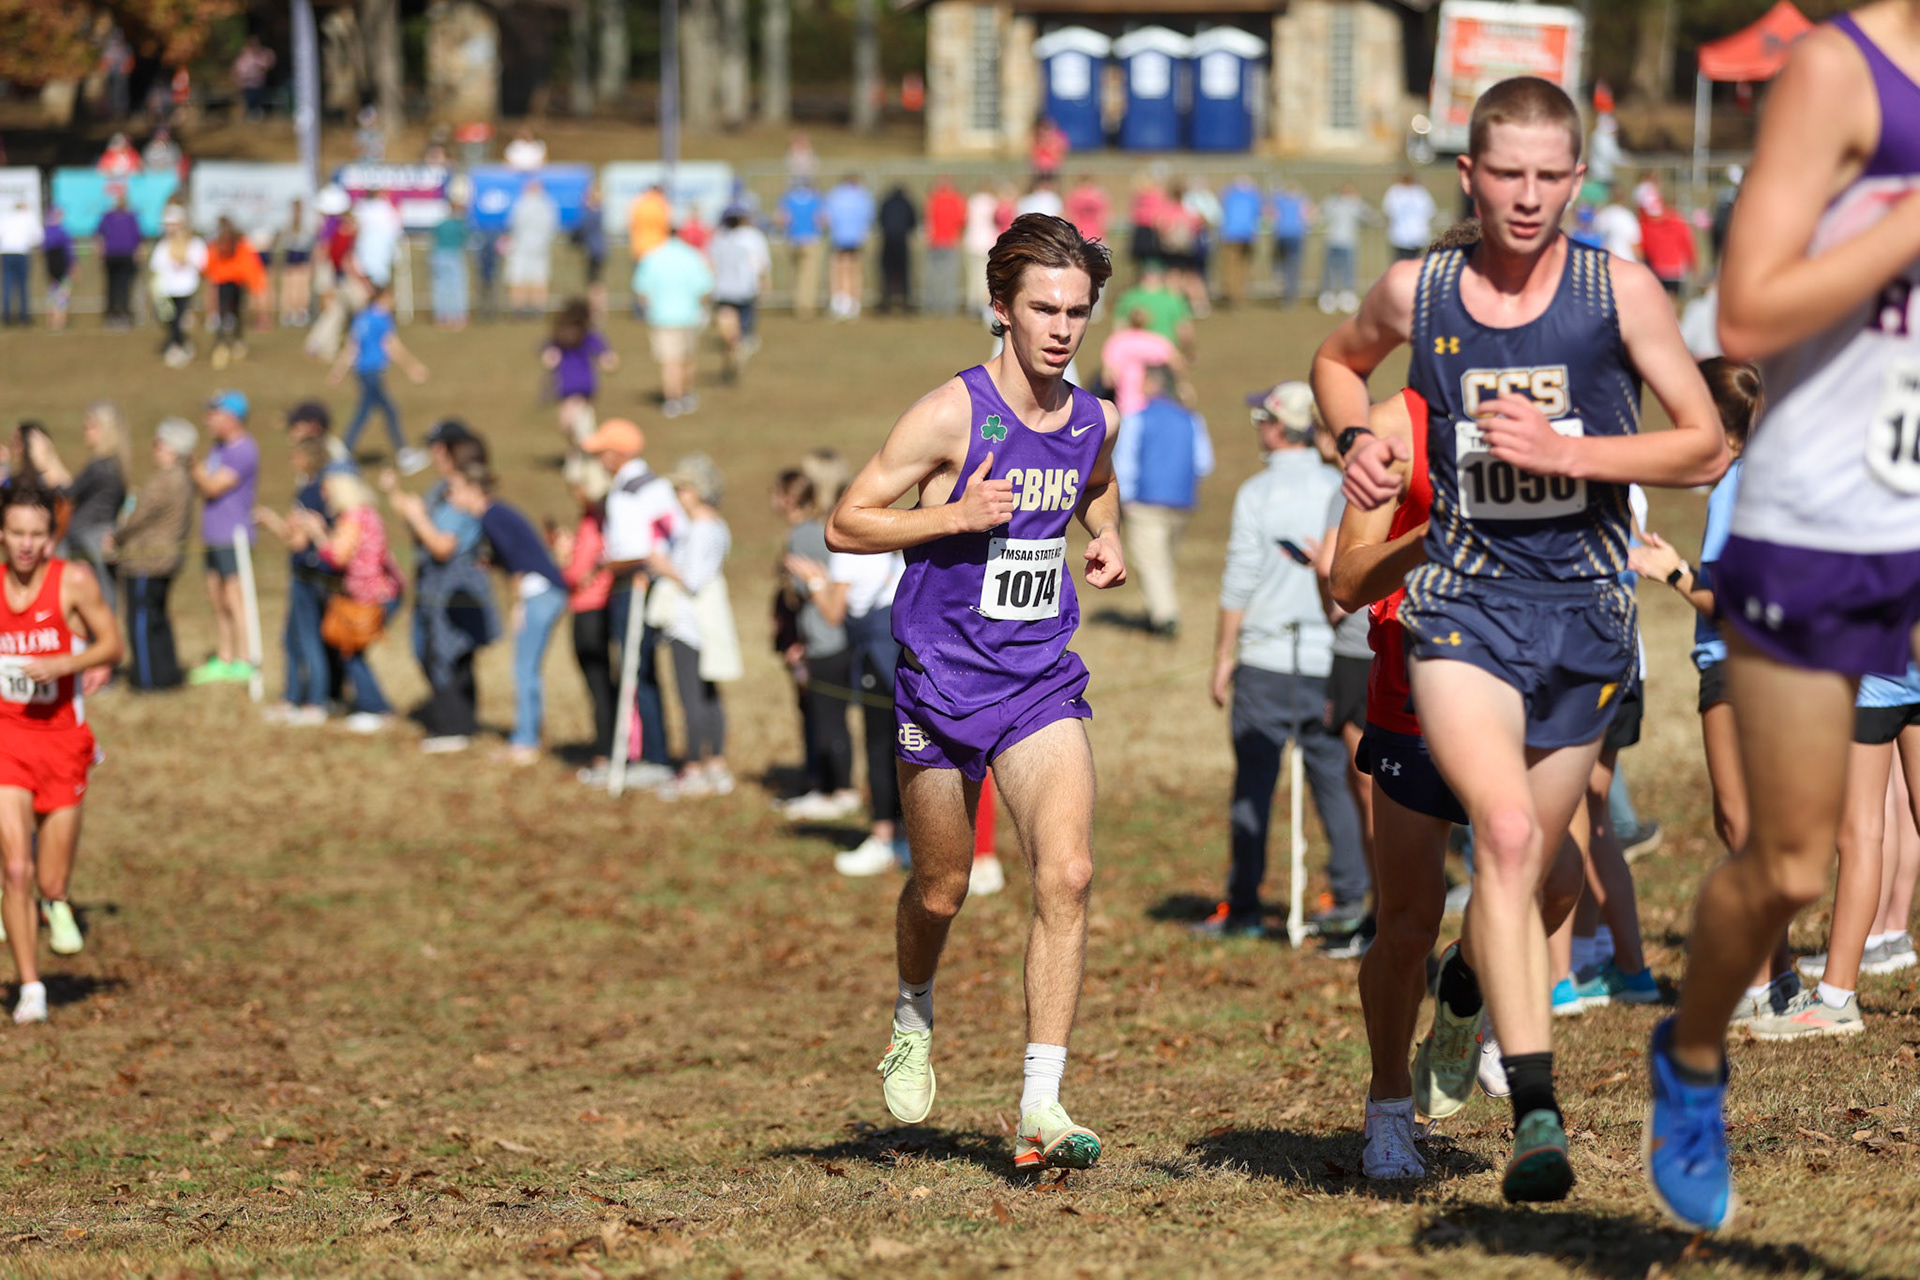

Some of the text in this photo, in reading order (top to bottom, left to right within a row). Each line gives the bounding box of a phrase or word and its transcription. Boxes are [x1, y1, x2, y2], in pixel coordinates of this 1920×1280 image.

[1005, 468, 1080, 511] CBHS
[1000, 548, 1033, 561] TMSAA
[1034, 549, 1055, 561] STATE
[995, 568, 1057, 608] 1074
